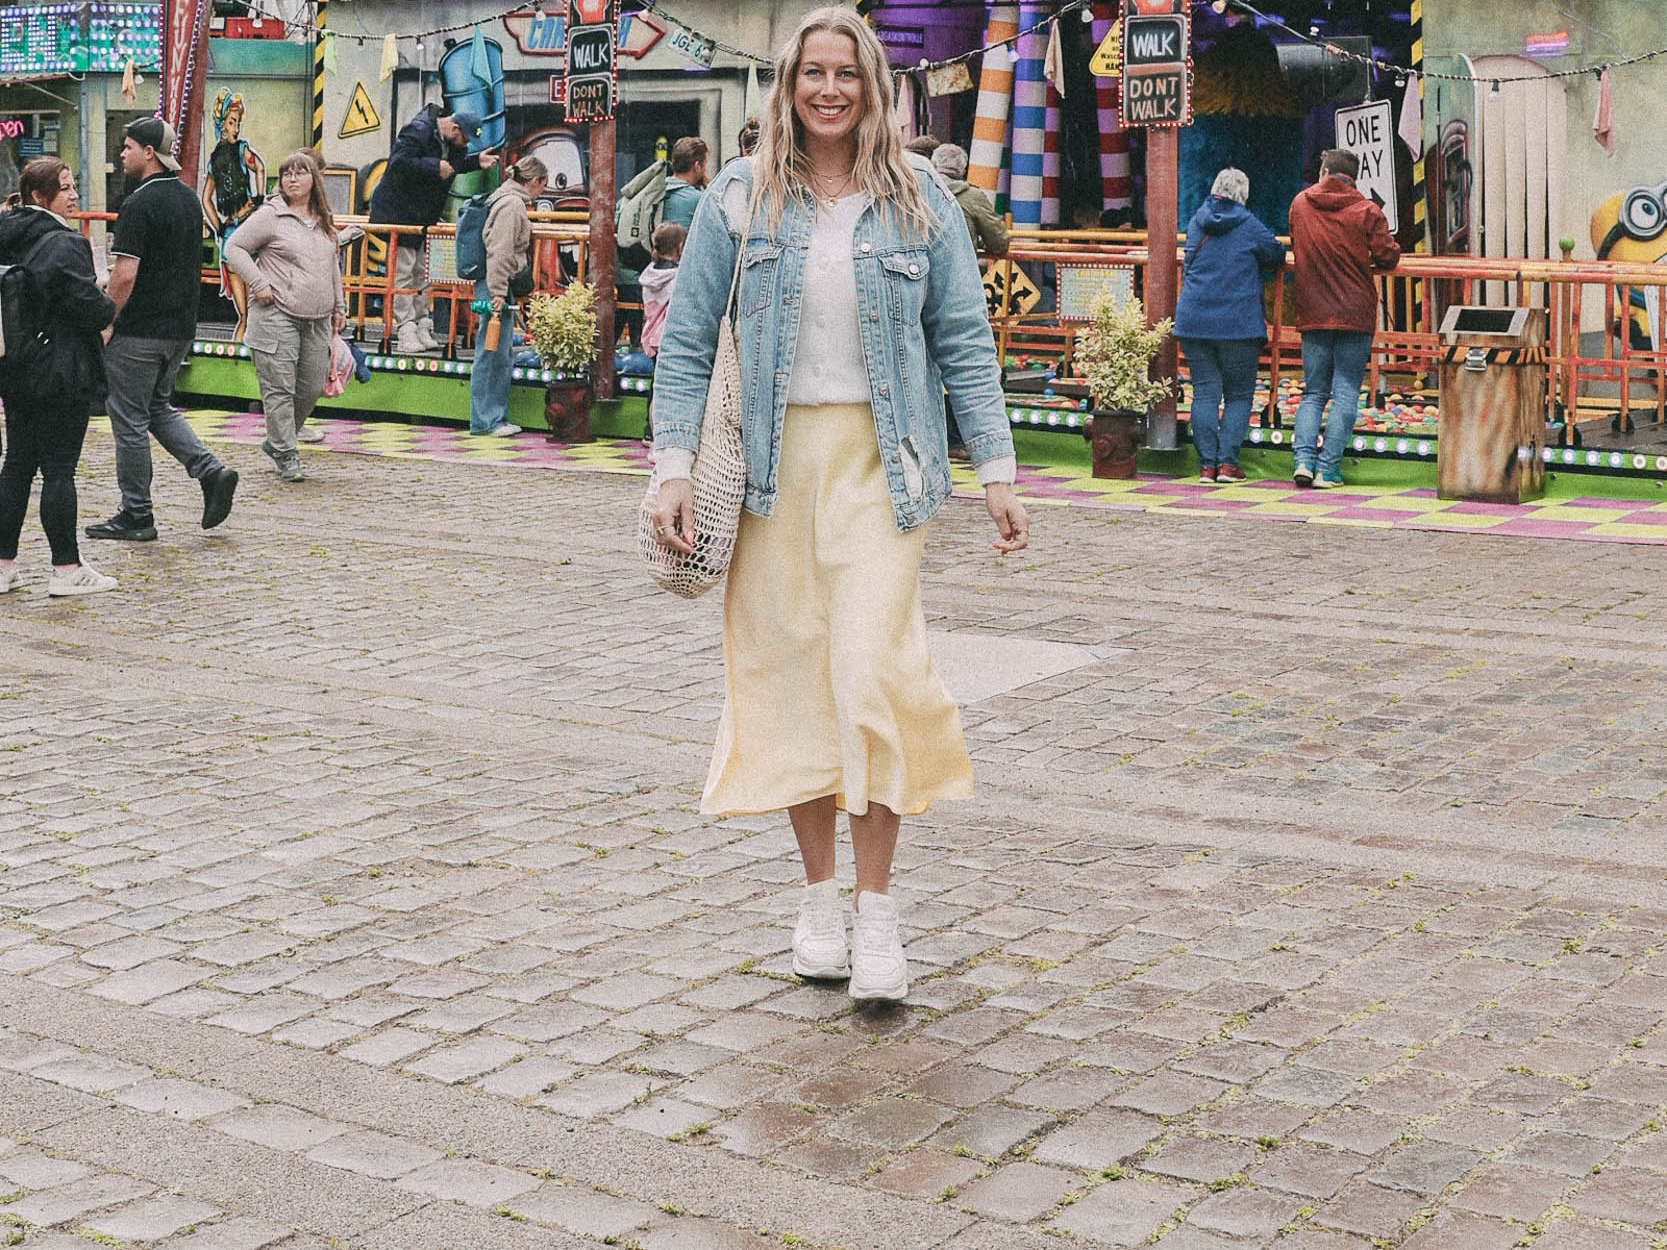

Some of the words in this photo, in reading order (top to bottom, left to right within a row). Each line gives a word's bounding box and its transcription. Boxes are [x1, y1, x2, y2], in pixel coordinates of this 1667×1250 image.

[573, 43, 609, 69] WALK
[1132, 31, 1175, 58] WALK
[573, 84, 604, 99] DONT
[1129, 77, 1179, 98] DONT
[573, 100, 605, 118] WALK
[1131, 98, 1177, 120] WALK
[1346, 115, 1381, 147] ONE
[1359, 150, 1383, 180] AY
